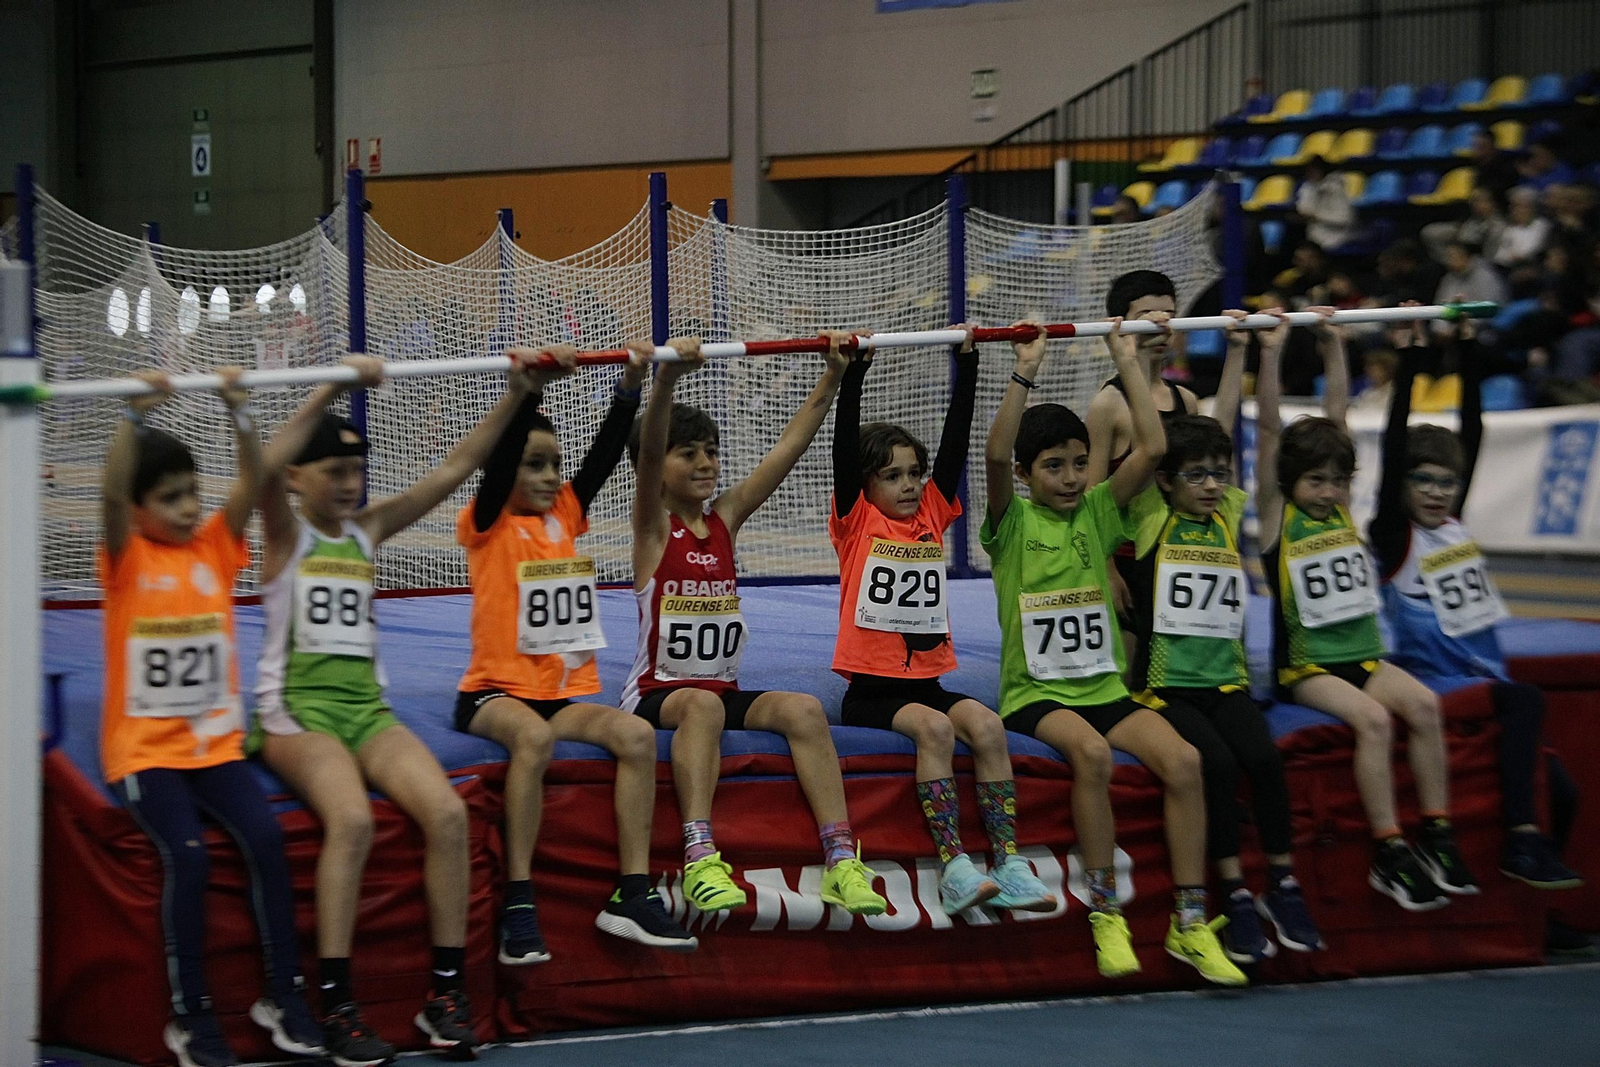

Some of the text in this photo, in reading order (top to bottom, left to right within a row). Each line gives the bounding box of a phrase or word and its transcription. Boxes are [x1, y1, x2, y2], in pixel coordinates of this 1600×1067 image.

[873, 543, 942, 559] OURENSE 2025
[1165, 549, 1221, 563] OURENSE
[1289, 533, 1342, 557] OURENSE
[663, 580, 679, 596] O
[868, 565, 941, 608] 829
[1168, 571, 1240, 613] 674
[1302, 551, 1368, 600] 683
[527, 584, 593, 628] 809
[665, 599, 722, 612] OURENSE
[1025, 592, 1081, 609] OURENSE
[666, 621, 743, 661] 500
[1032, 612, 1104, 655] 795
[145, 643, 219, 688] 821
